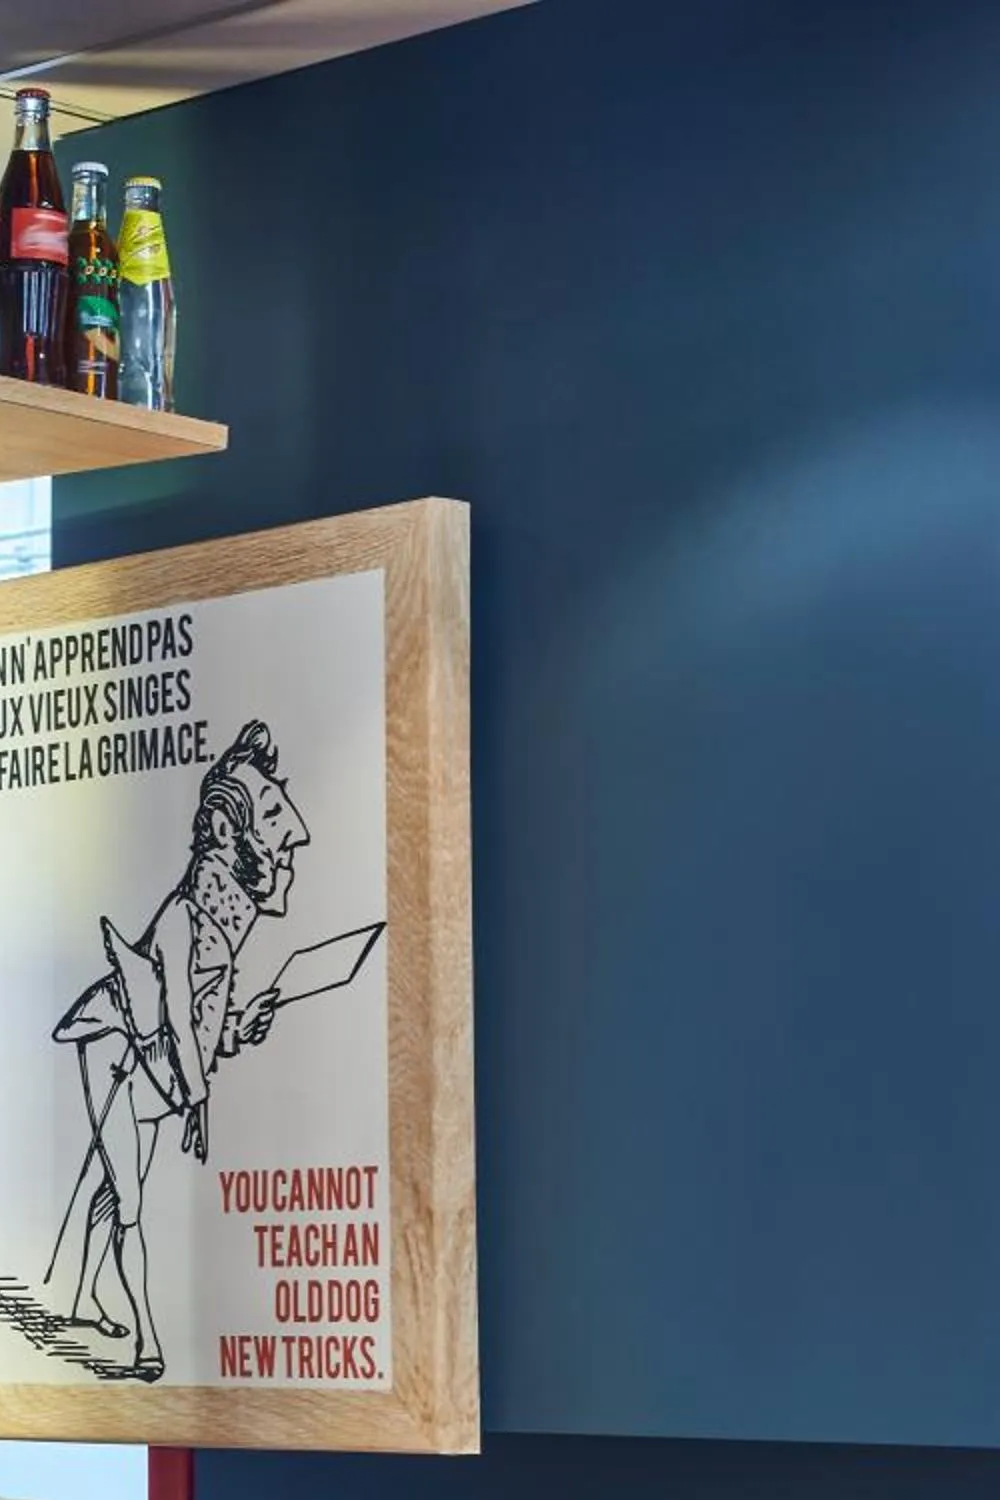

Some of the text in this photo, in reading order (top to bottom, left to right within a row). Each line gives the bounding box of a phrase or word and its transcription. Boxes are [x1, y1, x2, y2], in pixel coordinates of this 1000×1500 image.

[11, 623, 144, 685] N'APPREND
[147, 614, 193, 661] PAS
[28, 684, 99, 734] VIEUX
[103, 669, 191, 722] SINGES
[64, 738, 93, 782] LA
[98, 720, 216, 777] GRIMACE.
[219, 1166, 378, 1213] YOU CANNOT
[254, 1222, 379, 1267] TEACH AN
[275, 1279, 380, 1322] OLD DOG
[219, 1335, 384, 1380] NEW TRICKS.
